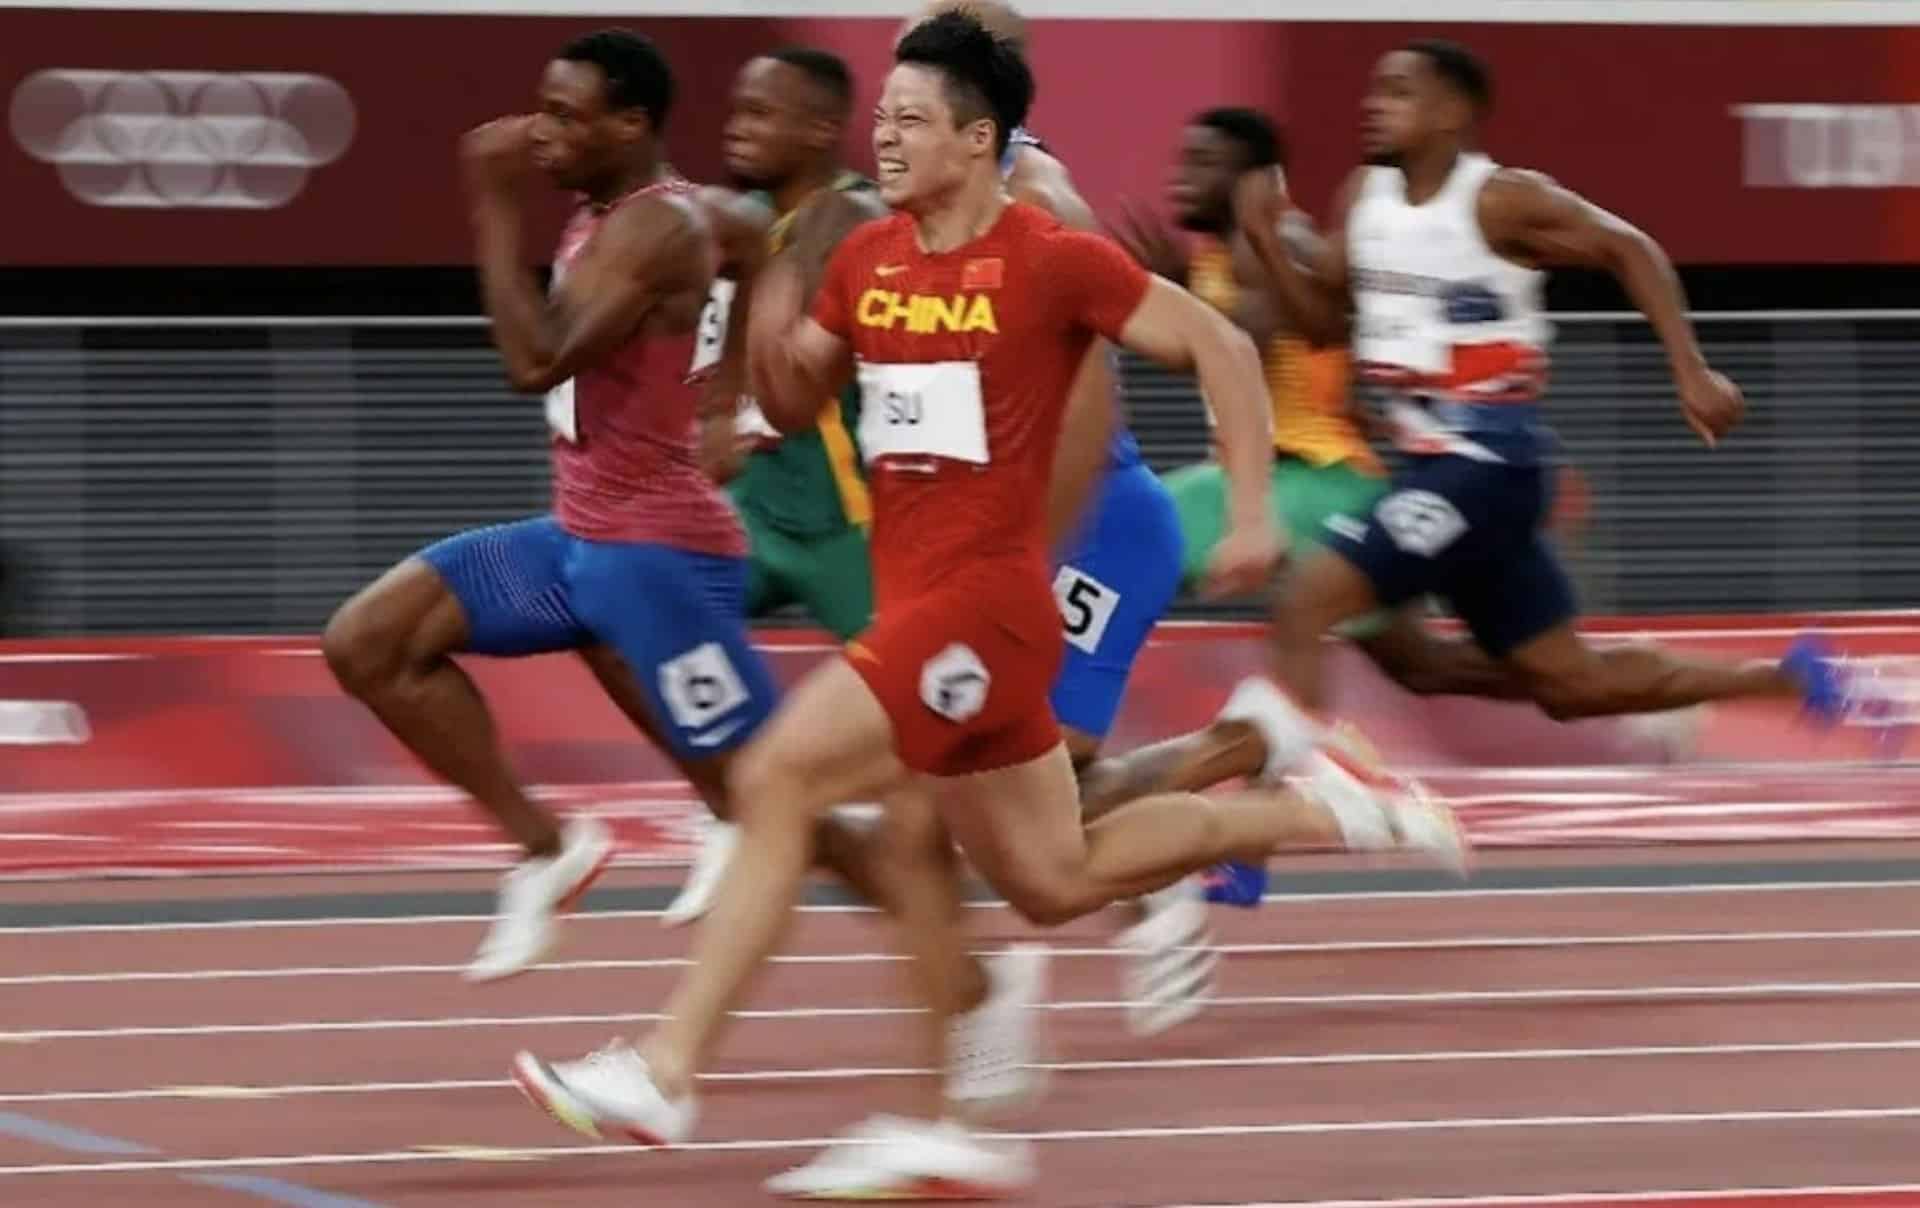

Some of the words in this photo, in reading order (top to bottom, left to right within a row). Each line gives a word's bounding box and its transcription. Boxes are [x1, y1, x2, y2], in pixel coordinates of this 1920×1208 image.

[857, 288, 999, 334] CHINA
[884, 391, 923, 426] SU
[1061, 576, 1102, 636] 5
